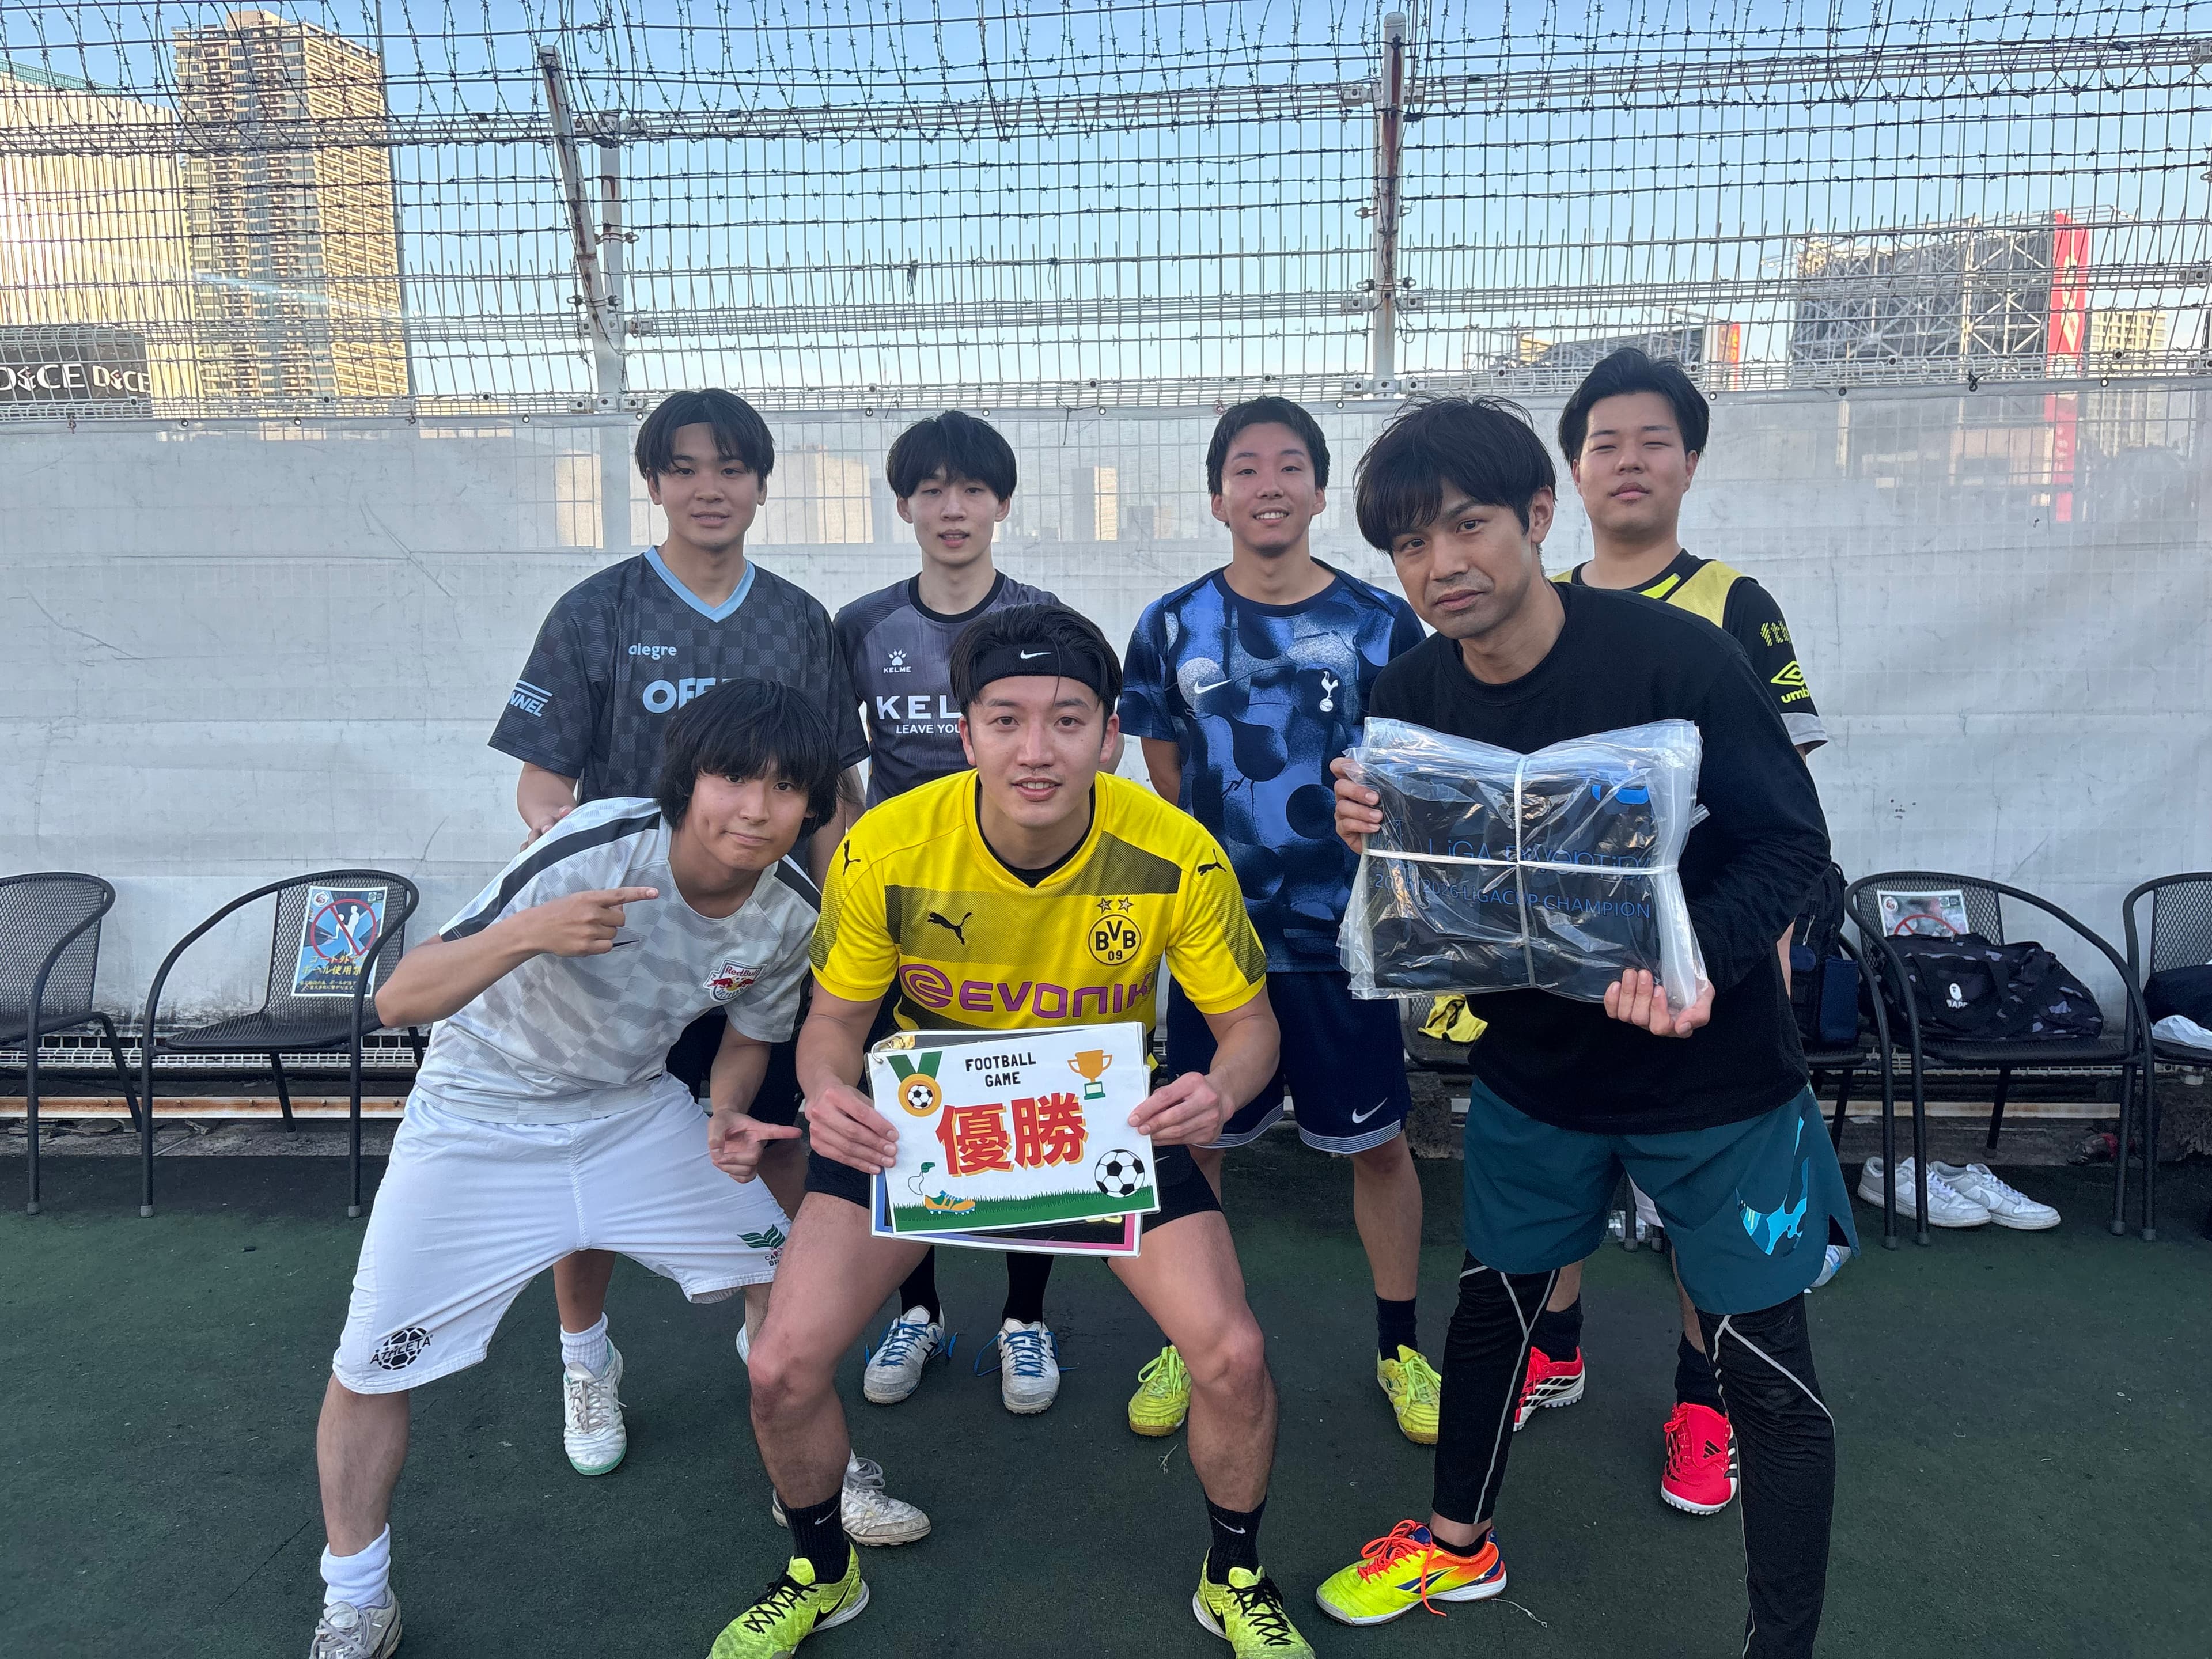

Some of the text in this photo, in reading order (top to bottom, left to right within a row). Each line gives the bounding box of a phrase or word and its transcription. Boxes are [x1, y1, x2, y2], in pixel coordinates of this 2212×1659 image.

[628, 643, 677, 660] alegre
[876, 695, 963, 719] KEL
[896, 724, 934, 734] LEAVE
[1543, 895, 1650, 918] CHAMPION
[1096, 920, 1136, 951] BVB
[1108, 950, 1123, 961] 09
[965, 1052, 1037, 1072] FOOTBALL
[984, 1071, 1021, 1088] GAME
[935, 1092, 1089, 1177] 優勝
[369, 1336, 431, 1365] ATHLETA
